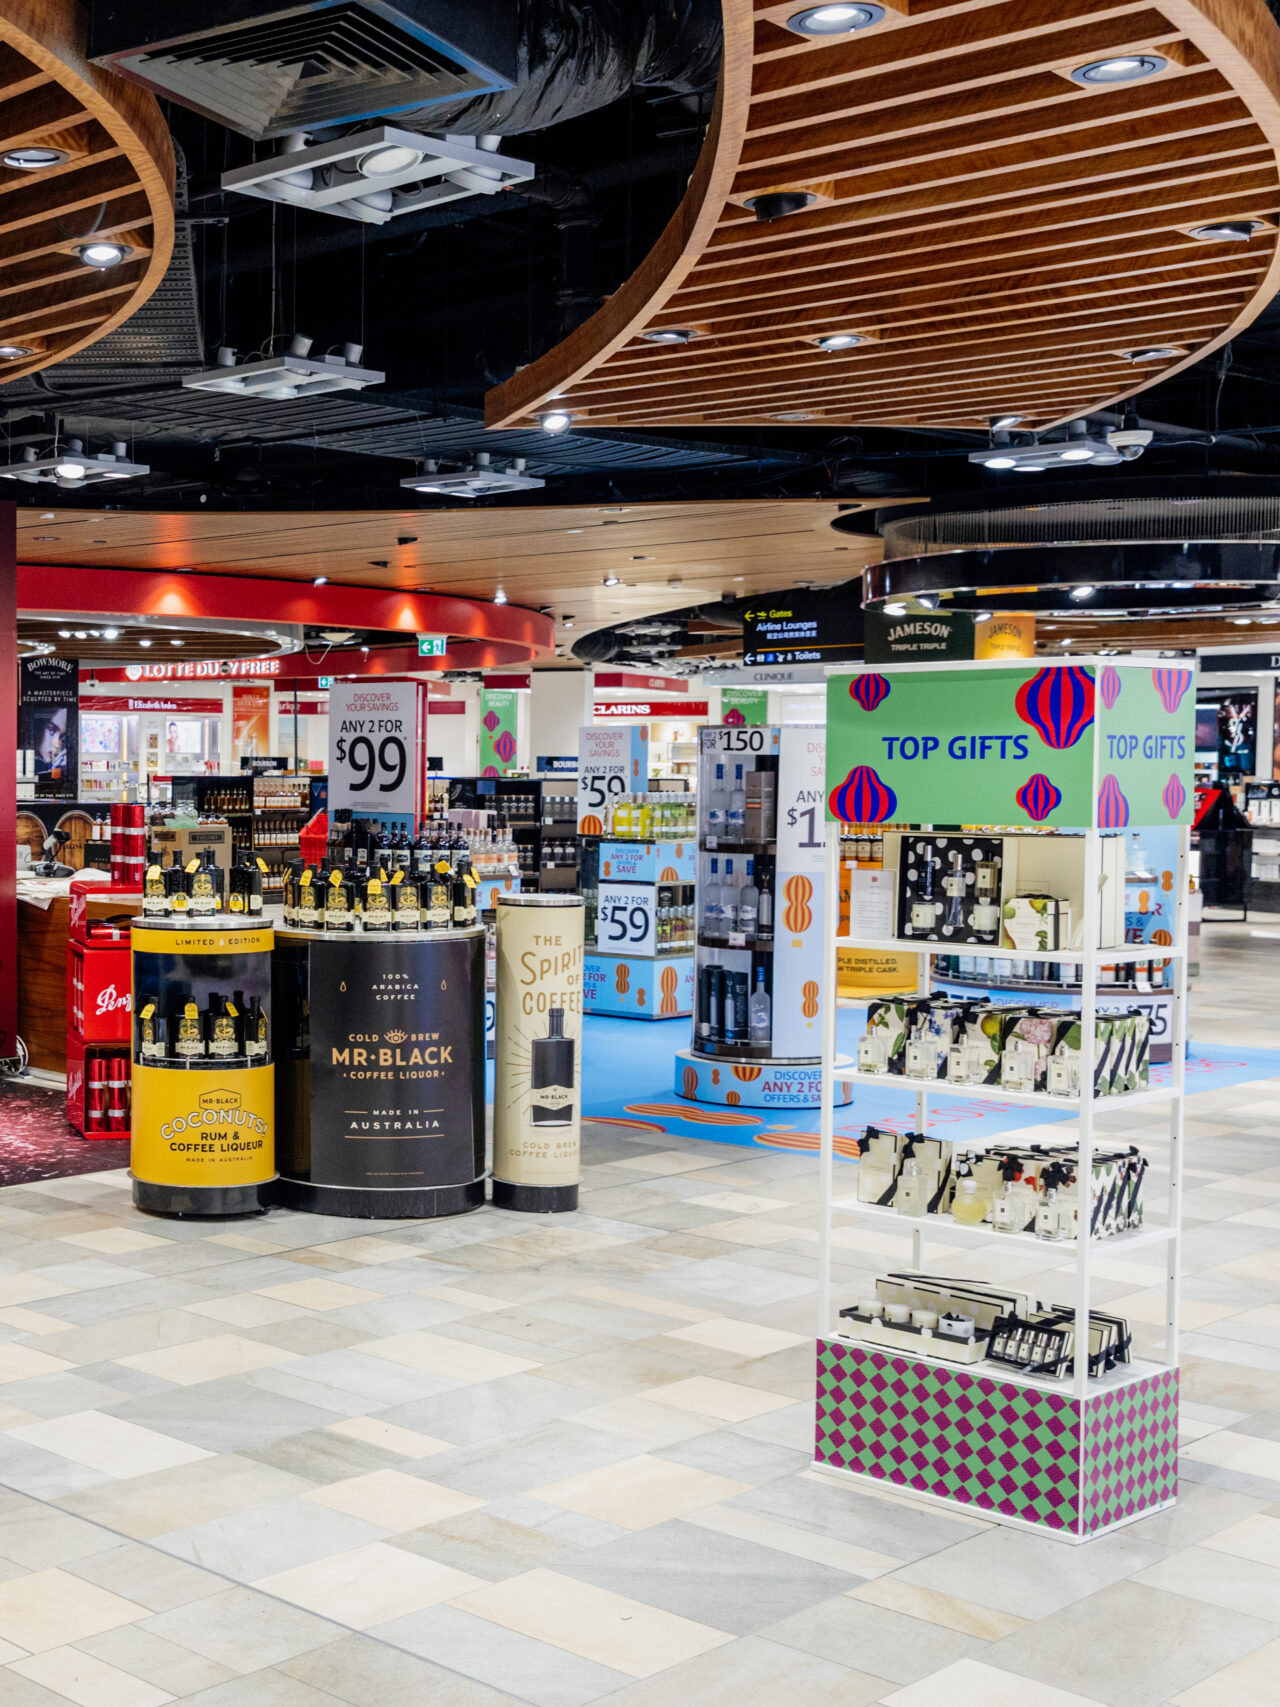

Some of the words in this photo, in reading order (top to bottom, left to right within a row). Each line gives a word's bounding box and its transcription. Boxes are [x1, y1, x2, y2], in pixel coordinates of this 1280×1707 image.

[768, 610, 792, 618] Gates
[756, 622, 782, 632] Airline
[782, 621, 818, 630] Lounges
[887, 622, 950, 640] JAMESON
[988, 622, 1022, 639] JAMESON
[920, 642, 947, 650] TRIPLE
[794, 652, 821, 660] Toilets
[26, 658, 74, 673] BOWMORE
[144, 664, 194, 677] LOTTE
[196, 662, 238, 676] DUY
[240, 660, 280, 674] FREE
[753, 672, 794, 681] CLINIQUE
[353, 693, 391, 702] DISCOVER
[135, 700, 160, 709] Elizabeth
[161, 701, 177, 709] Arden
[346, 703, 366, 712] YOUR
[367, 703, 399, 712] SAVINGS
[488, 700, 510, 708] BEAUTY
[593, 704, 650, 714] CLARINS
[340, 720, 366, 733] ANY
[368, 720, 375, 733] 2
[379, 720, 403, 732] FOR
[586, 732, 623, 740] DISCOVER
[718, 730, 764, 751] $150
[704, 739, 716, 749] FOR
[882, 736, 940, 760] TOP
[948, 735, 1028, 760] GIFTS
[1106, 735, 1138, 759] TOP
[1142, 735, 1185, 760] GIFTS
[553, 760, 578, 768] BOURB
[584, 766, 600, 774] ANY
[604, 896, 622, 904] ANY
[624, 896, 629, 904] 2
[631, 896, 649, 905] FOR
[601, 906, 649, 942] $59
[228, 937, 260, 945] EDITION
[534, 935, 563, 946] THE
[520, 945, 583, 986] SPIRIT
[567, 974, 580, 986] OF
[588, 973, 606, 982] FOR
[522, 990, 581, 1015] COFFEE
[348, 1034, 379, 1042] COLD
[411, 1032, 440, 1042] BREW
[350, 1070, 394, 1080] COFFEE
[399, 1070, 439, 1079] LIQUOR
[762, 1081, 793, 1093] ANY
[797, 1082, 804, 1092] 2
[808, 1082, 822, 1092] FO
[764, 1094, 800, 1103] OFFERS
[803, 1095, 809, 1103] &
[160, 1109, 268, 1140] COCONUTS!
[350, 1120, 440, 1130] AUSTRALIA
[201, 1132, 228, 1141] RUM
[232, 1132, 240, 1140] &
[170, 1142, 215, 1153] COFFEE
[220, 1140, 263, 1152] LIQUEUR
[509, 1149, 548, 1158] COFFEE
